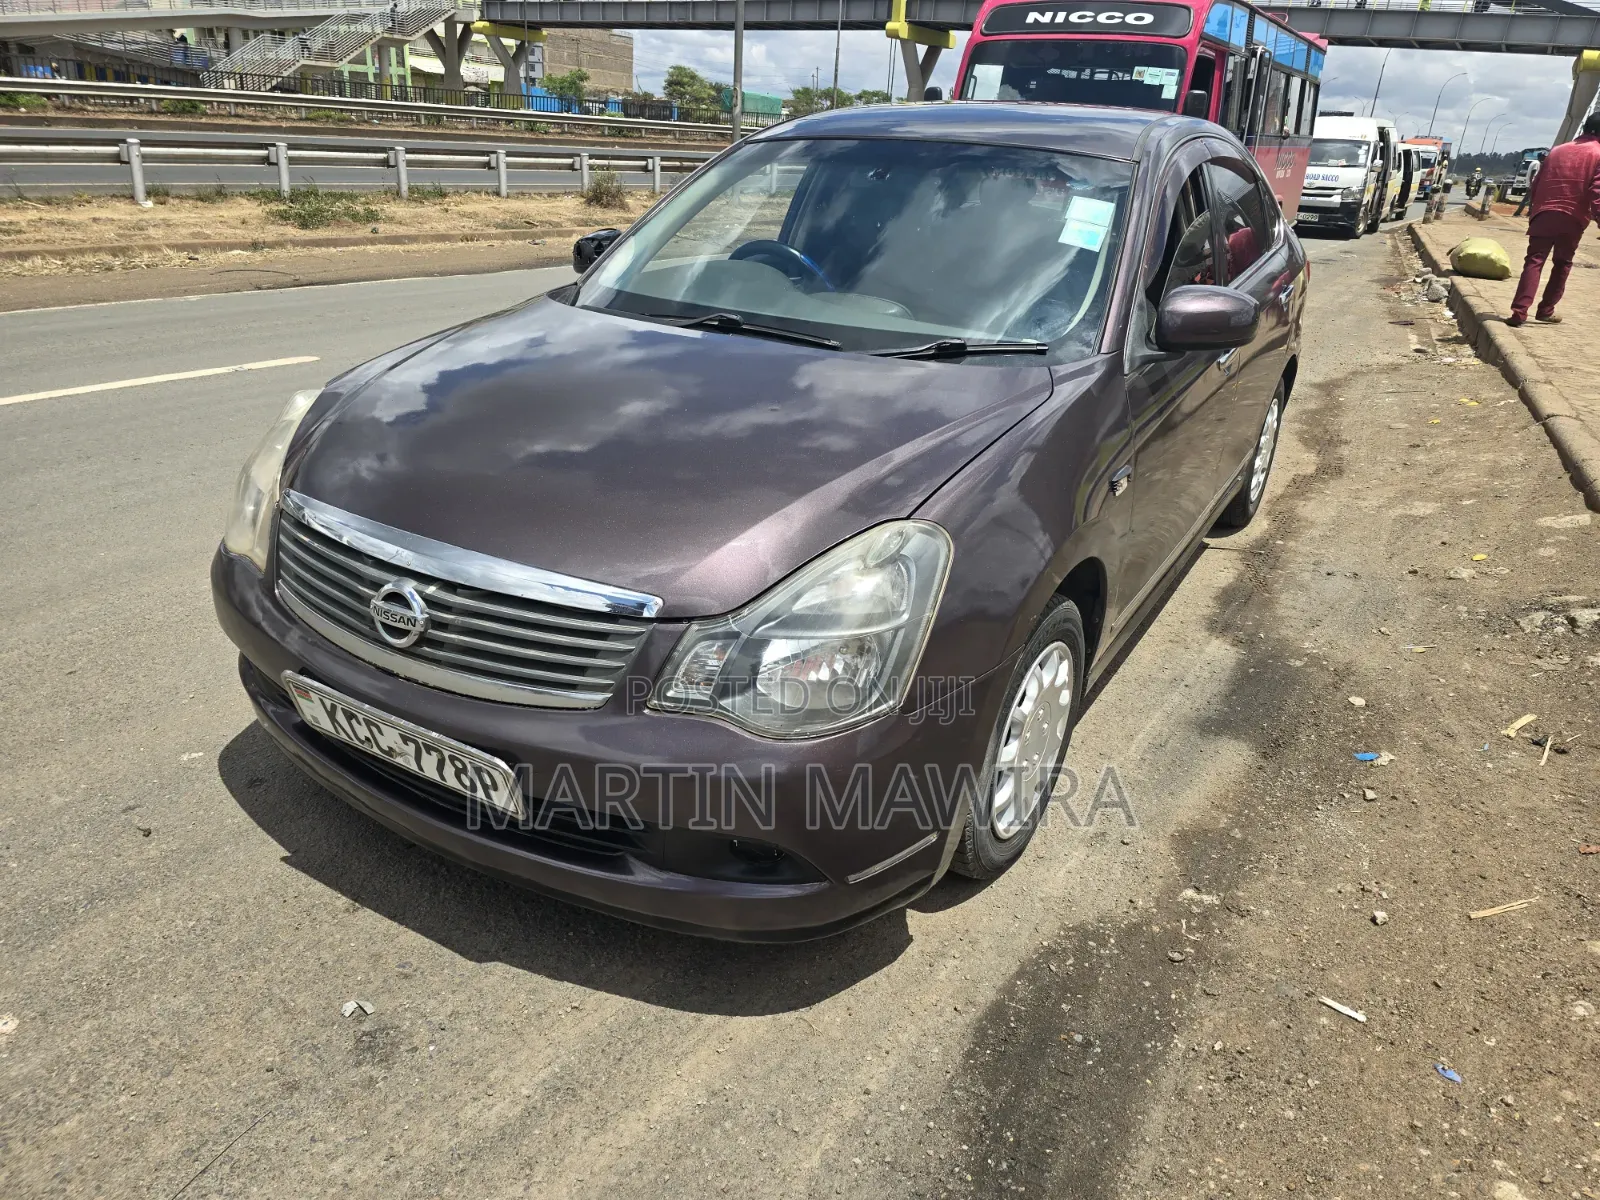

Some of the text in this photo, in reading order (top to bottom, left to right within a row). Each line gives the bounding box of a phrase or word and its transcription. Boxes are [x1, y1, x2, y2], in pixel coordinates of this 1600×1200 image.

[1025, 11, 1155, 25] NICCO
[373, 605, 417, 628] NISSAN
[319, 697, 499, 807] KCC 778P
